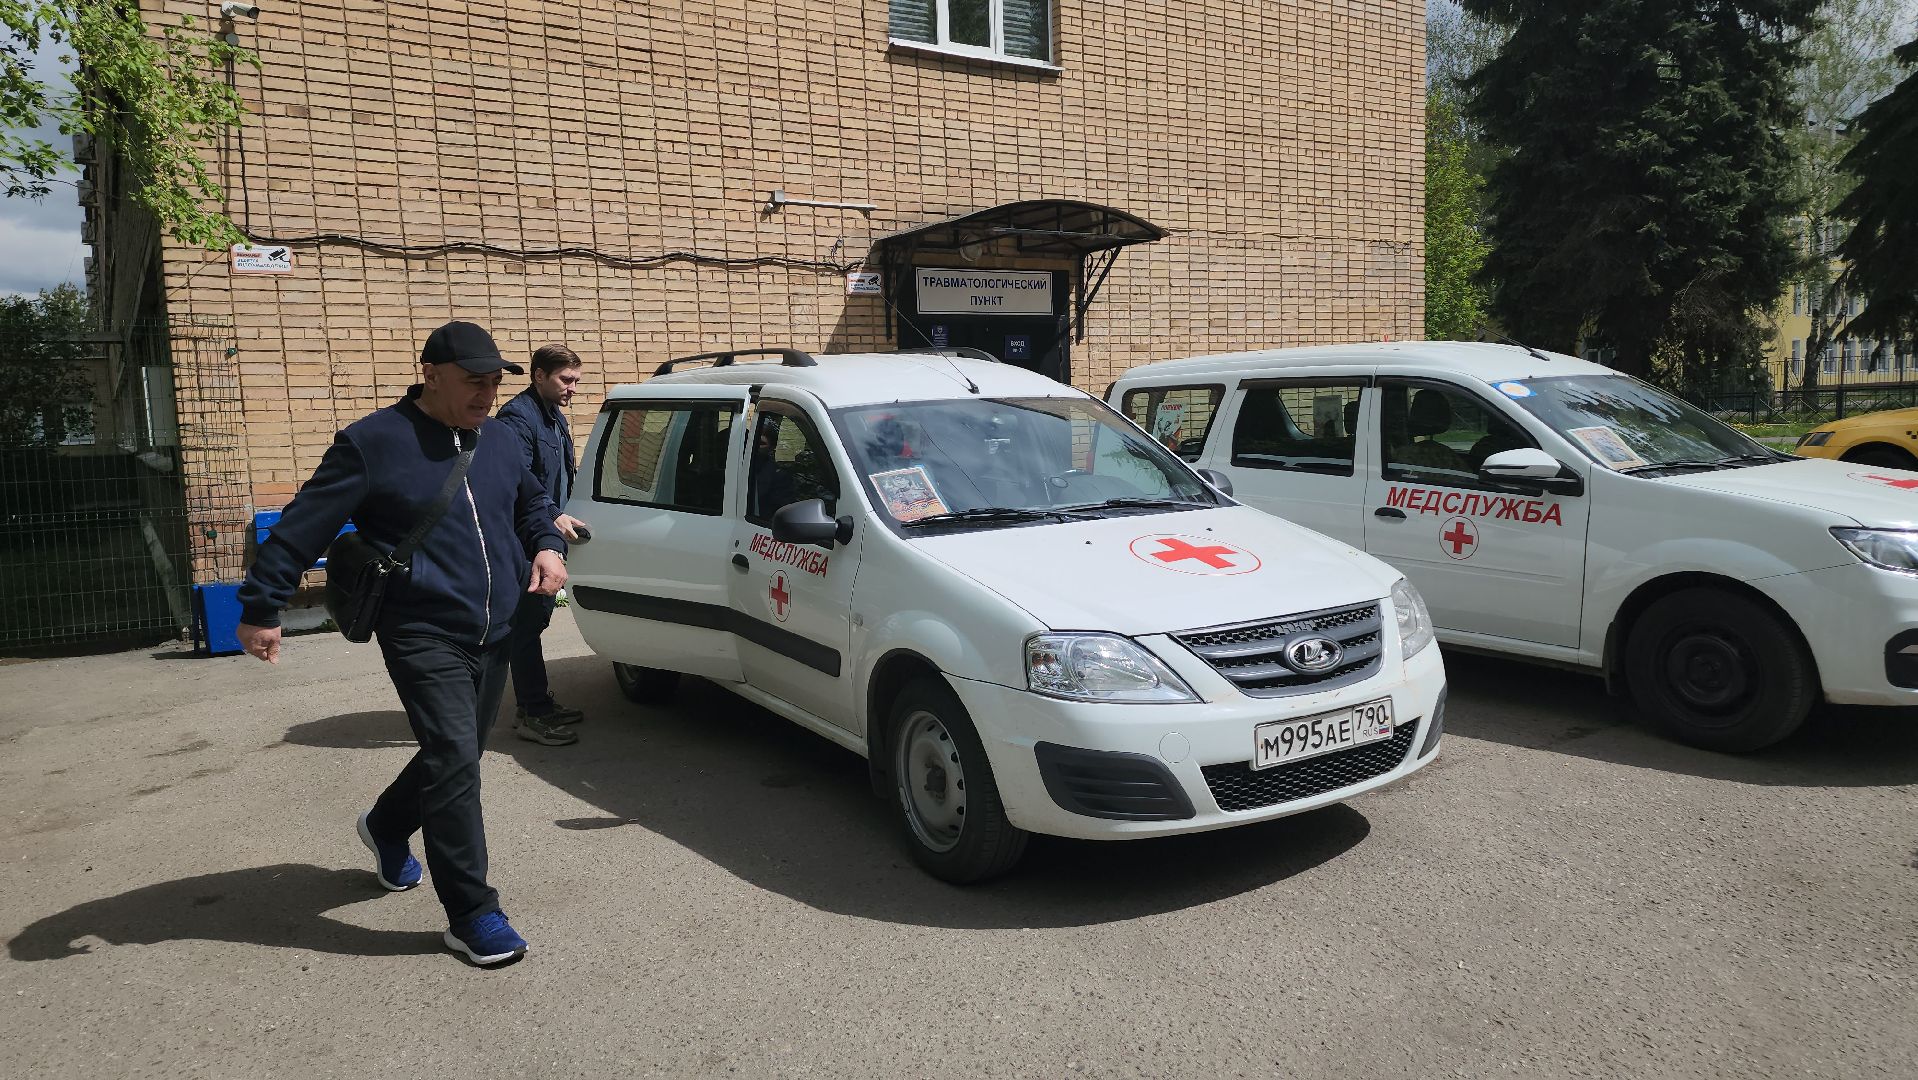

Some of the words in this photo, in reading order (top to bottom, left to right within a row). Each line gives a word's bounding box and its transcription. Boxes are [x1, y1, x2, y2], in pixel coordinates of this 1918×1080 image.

[922, 276, 1048, 290] ТРАВМАТОЛОГИЧЕСКИЙ
[970, 295, 1004, 306] ПУНКТ
[1386, 486, 1563, 527] МЕДСЛУЖБА
[749, 532, 829, 578] МЕДСЛУЖБА
[1355, 704, 1388, 731] 790
[1362, 726, 1379, 738] RUS
